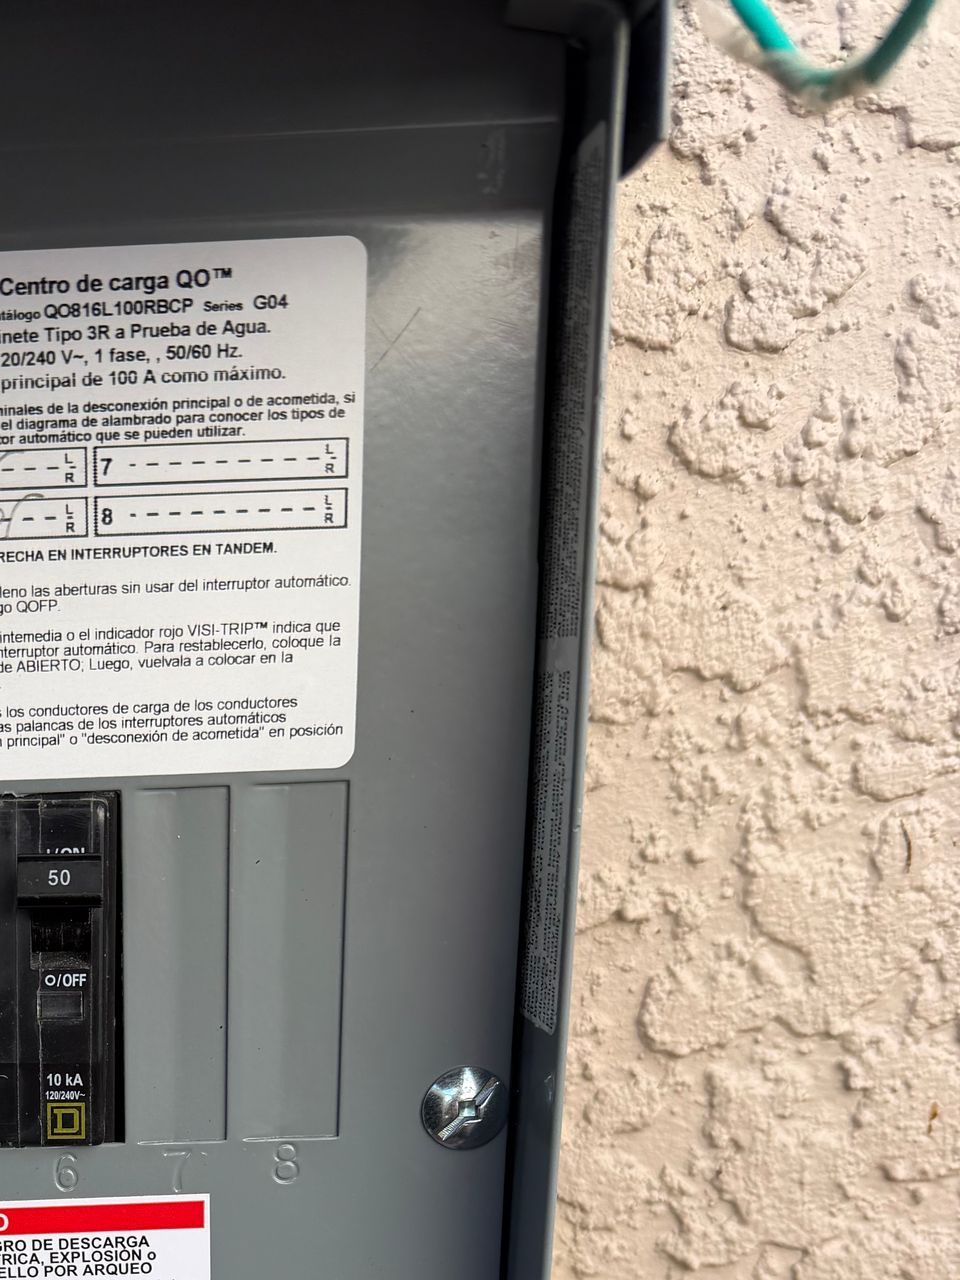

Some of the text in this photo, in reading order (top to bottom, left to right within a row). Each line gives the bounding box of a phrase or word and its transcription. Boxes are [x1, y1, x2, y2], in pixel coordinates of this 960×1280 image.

[76, 274, 102, 292] de
[108, 275, 169, 292] carga
[175, 267, 232, 288] QO™
[43, 297, 193, 319] QO816L100RBCP
[253, 294, 288, 309] G04
[43, 326, 82, 343] Tipo
[87, 324, 109, 340] 3R
[114, 327, 124, 339] a
[130, 322, 190, 338] Prueba
[195, 320, 217, 335] de
[221, 319, 270, 337] Agua.
[100, 457, 112, 476] 7
[101, 508, 113, 525] 8
[48, 870, 70, 886] 50
[47, 1074, 83, 1086] 10 kA
[45, 1090, 85, 1100] 120/240V~
[53, 1153, 79, 1192] 6
[271, 1144, 299, 1184] 8
[31, 1238, 53, 1250] DE
[58, 1236, 149, 1250] DESCARGA
[49, 1249, 141, 1263] EXPLOSIÓN
[147, 1251, 156, 1260] o
